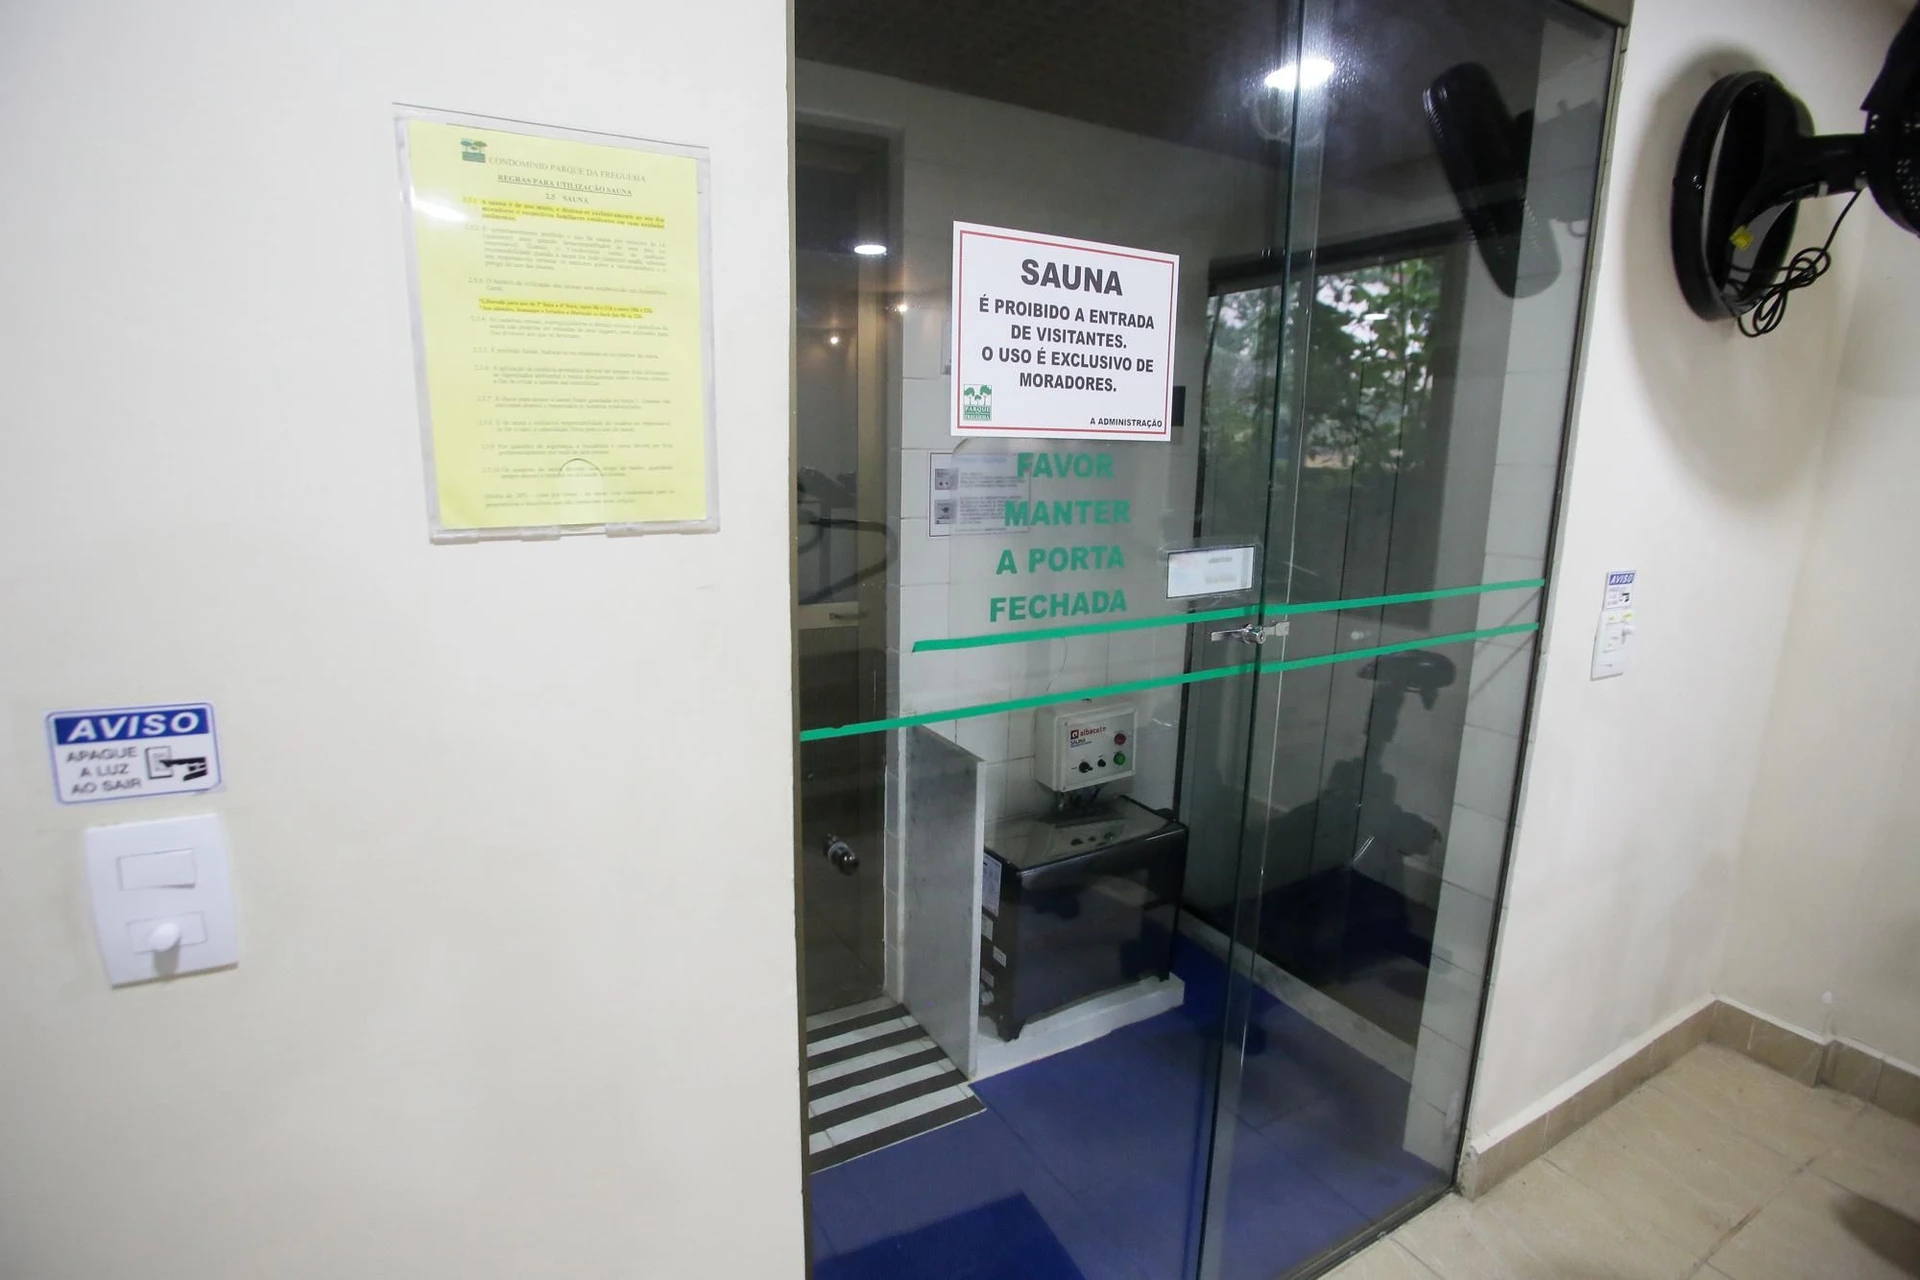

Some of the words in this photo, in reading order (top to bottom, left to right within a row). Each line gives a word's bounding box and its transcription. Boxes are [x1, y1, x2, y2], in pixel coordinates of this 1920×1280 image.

[550, 163, 583, 176] PARQUE
[586, 168, 599, 178] DA
[600, 171, 646, 183] FREGUESIA
[498, 174, 532, 185] REGRAS
[533, 178, 554, 188] PARA
[556, 181, 606, 194] UTILIZAÇÃO
[606, 187, 632, 196] SAUNA
[562, 195, 589, 204] SAUNA
[1021, 258, 1123, 296] SAUNA
[979, 294, 989, 312] É
[995, 298, 1071, 321] PROIBIDO
[1075, 307, 1085, 322] A
[1090, 308, 1155, 330] ENTRADA
[1011, 324, 1031, 340] DE
[1036, 326, 1127, 349] VISITANTES.
[982, 346, 993, 361] O
[999, 347, 1032, 364] USO
[1037, 347, 1047, 365] É
[1051, 351, 1132, 372] EXCLUSIVO
[1136, 358, 1154, 373] DE
[1019, 372, 1118, 393] MORADORES.
[1090, 417, 1096, 425] A
[1098, 416, 1163, 428] ADMINISTRAÇÃO
[1017, 452, 1114, 479] FAVOR
[1004, 499, 1131, 526] MANTER
[995, 549, 1018, 575] A
[1028, 545, 1125, 573] PORTA
[1610, 574, 1634, 584] AVISO
[990, 588, 1127, 622] FECHADA
[66, 711, 200, 742] AVISO
[65, 746, 138, 763] APAGUE
[79, 767, 92, 778] A
[97, 763, 130, 777] LUZ
[71, 781, 98, 795] AO
[102, 778, 142, 792] SAIR
